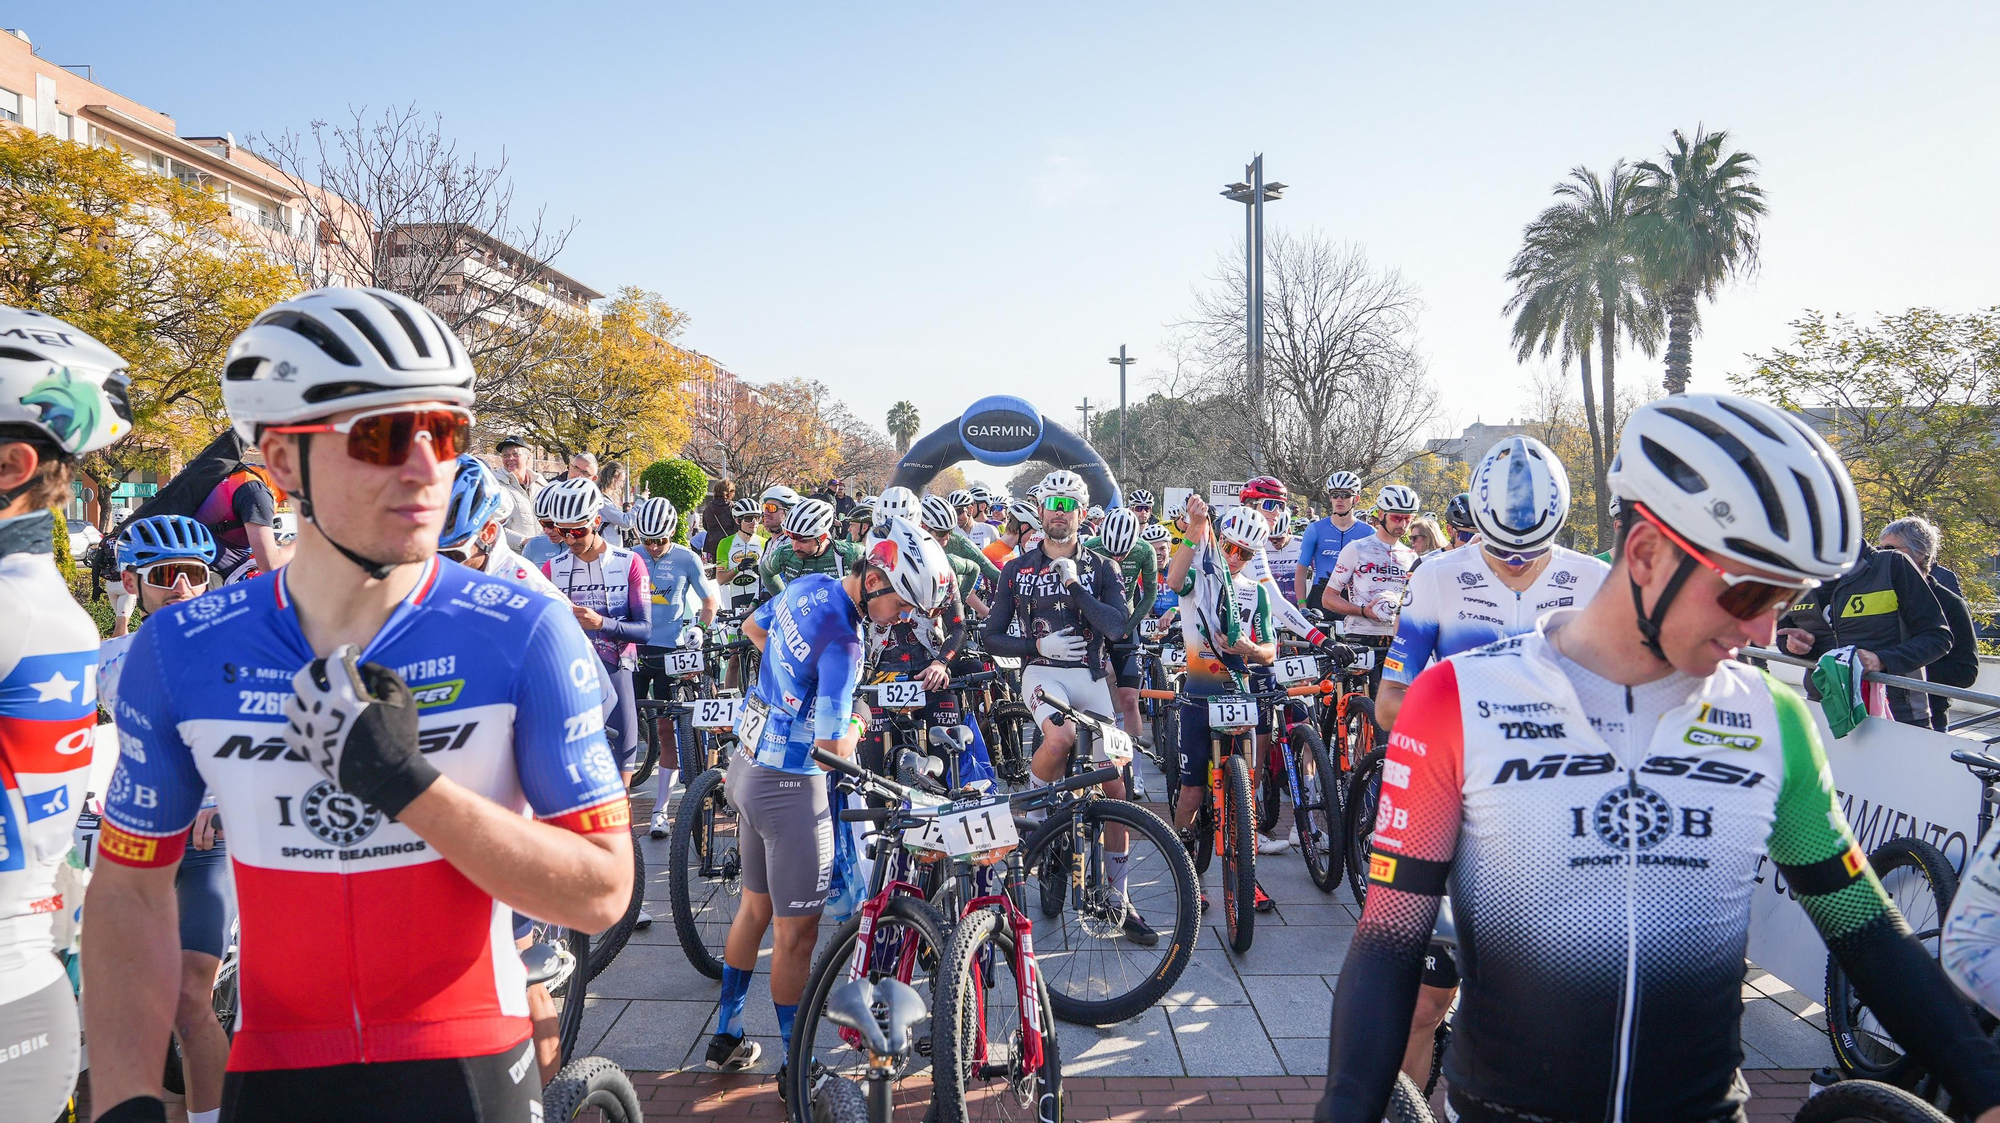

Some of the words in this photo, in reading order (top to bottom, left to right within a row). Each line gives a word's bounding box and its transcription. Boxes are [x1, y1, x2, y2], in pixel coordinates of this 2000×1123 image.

[903, 461, 934, 469] garmin.com
[1069, 461, 1100, 470] garmin.com
[1212, 484, 1228, 494] ELITE
[1481, 456, 1494, 515] RUDY
[903, 532, 925, 567] MET
[671, 653, 698, 670] 15-2
[1285, 658, 1306, 677] 6-1
[886, 684, 919, 703] 52-2
[702, 701, 733, 722] 52-1
[1217, 704, 1248, 722] 13-1
[779, 780, 801, 788] GOBIK
[958, 811, 997, 845] 1-1
[281, 847, 334, 861] SPORT
[339, 840, 426, 860] BEARINGS
